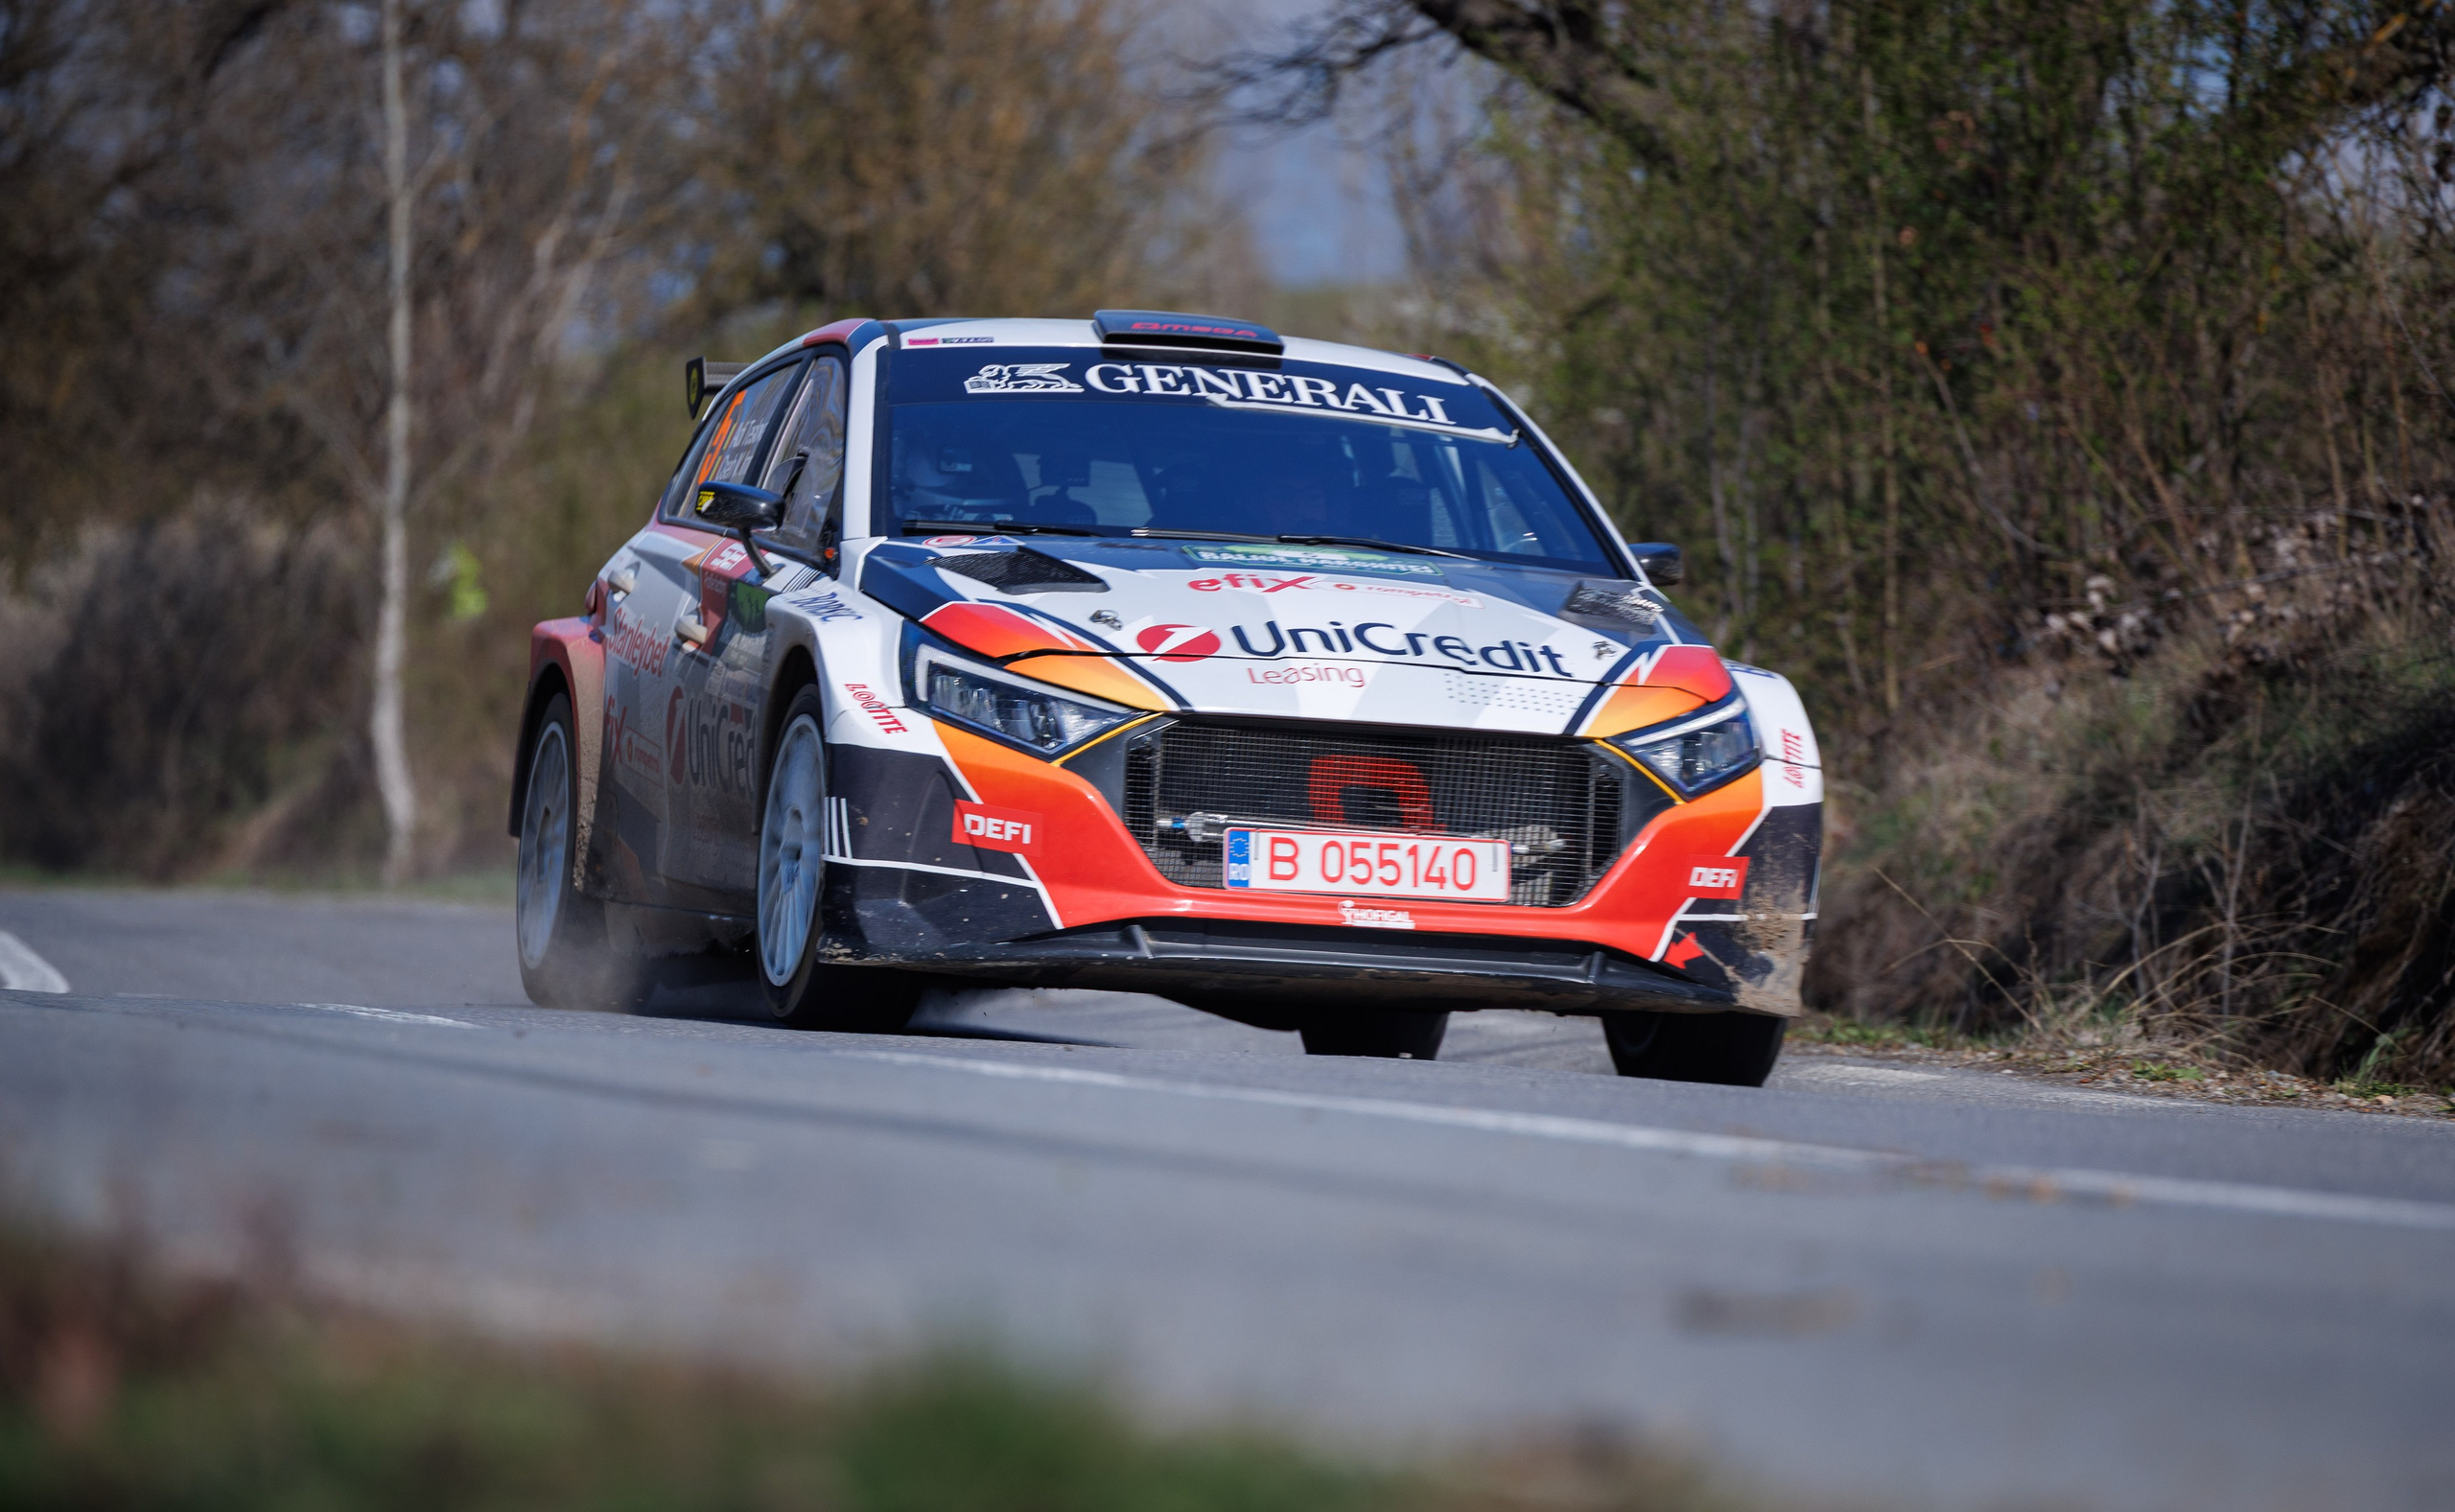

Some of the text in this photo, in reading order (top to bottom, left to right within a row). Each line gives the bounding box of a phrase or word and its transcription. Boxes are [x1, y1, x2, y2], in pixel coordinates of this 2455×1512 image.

[1085, 362, 1457, 425] GENERALI
[1188, 573, 1318, 593] efix
[606, 607, 670, 679] Stanleybet
[1230, 620, 1574, 679] UniCredit
[1247, 663, 1366, 688] Leasing
[844, 684, 908, 734] LOCTITE
[689, 697, 758, 798] UniCred
[964, 813, 1032, 845] DEFI
[1229, 863, 1249, 881] RO
[1269, 836, 1476, 892] B 055140
[1688, 866, 1741, 888] DEFI
